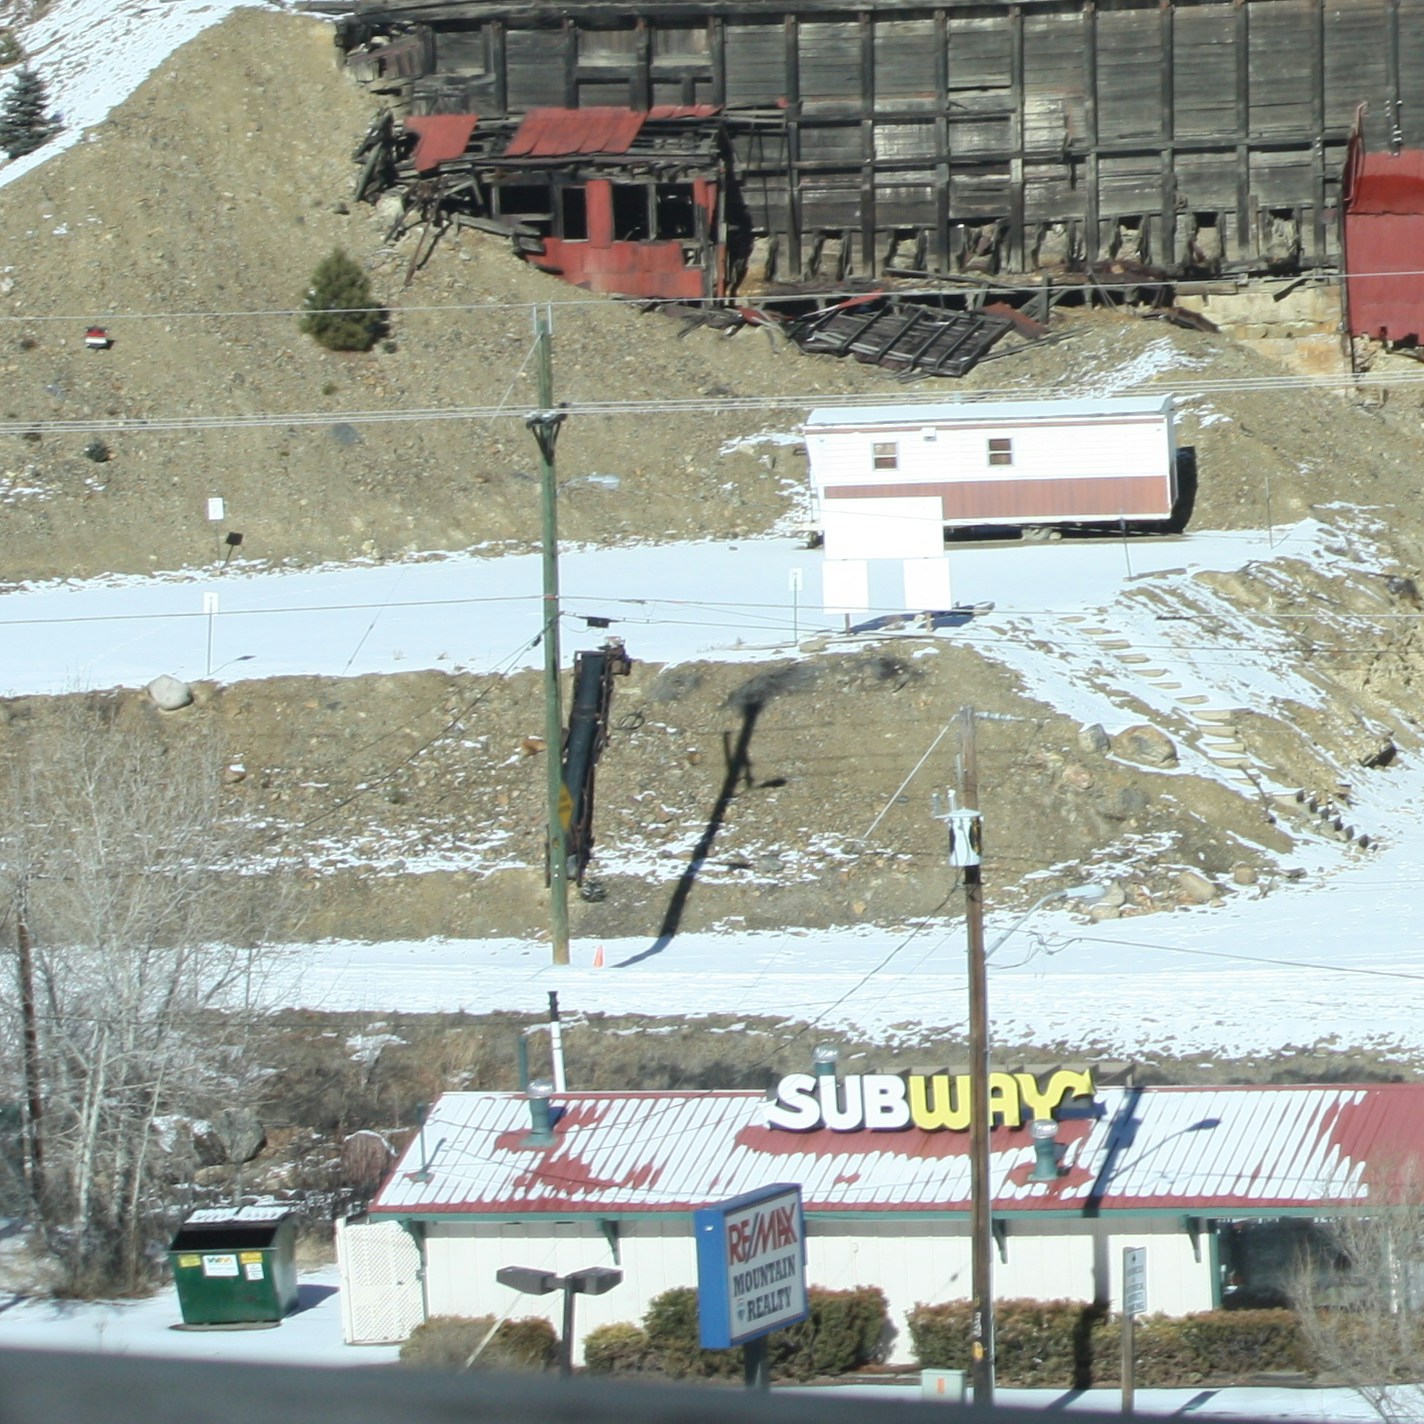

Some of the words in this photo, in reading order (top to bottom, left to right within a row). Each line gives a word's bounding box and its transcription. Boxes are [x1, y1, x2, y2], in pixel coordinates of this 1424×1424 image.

[763, 1068, 1095, 1130] SUBWAY
[728, 1202, 798, 1267] RE/MAX
[733, 1253, 796, 1298] MOUNTAIN
[747, 1285, 792, 1323] REALTY
